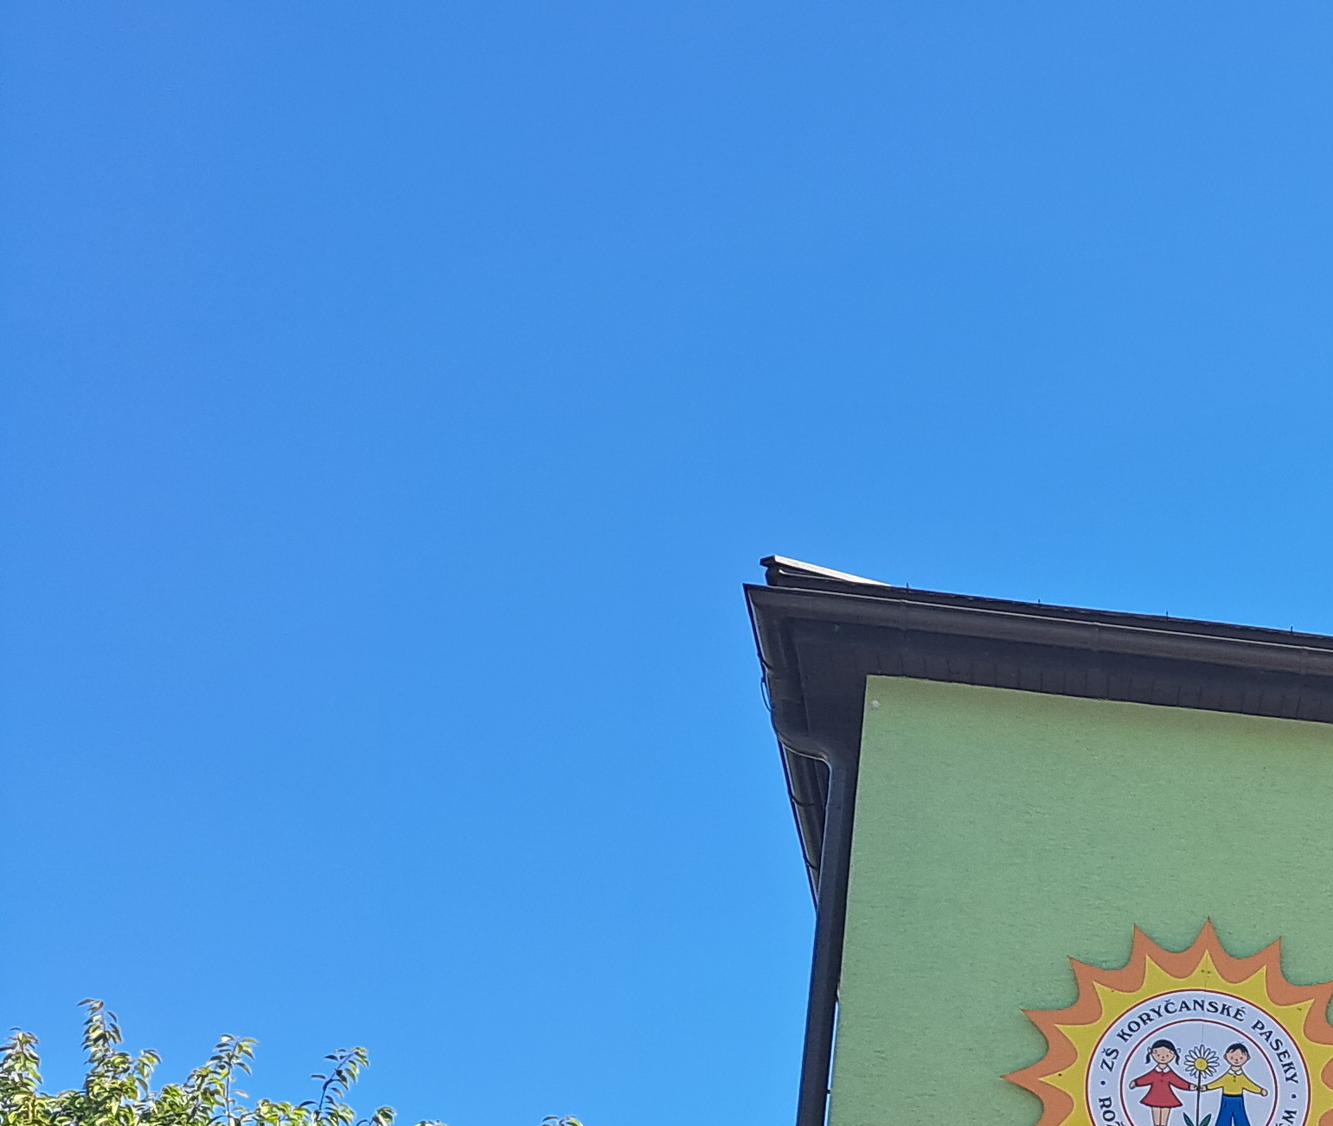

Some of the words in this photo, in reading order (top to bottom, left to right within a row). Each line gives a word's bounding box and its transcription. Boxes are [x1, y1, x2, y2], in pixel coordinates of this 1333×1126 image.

[1100, 1047, 1120, 1073] ZŠ
[1116, 999, 1246, 1043] KORYČANSKÉ
[1251, 1019, 1299, 1085] PASEKY
